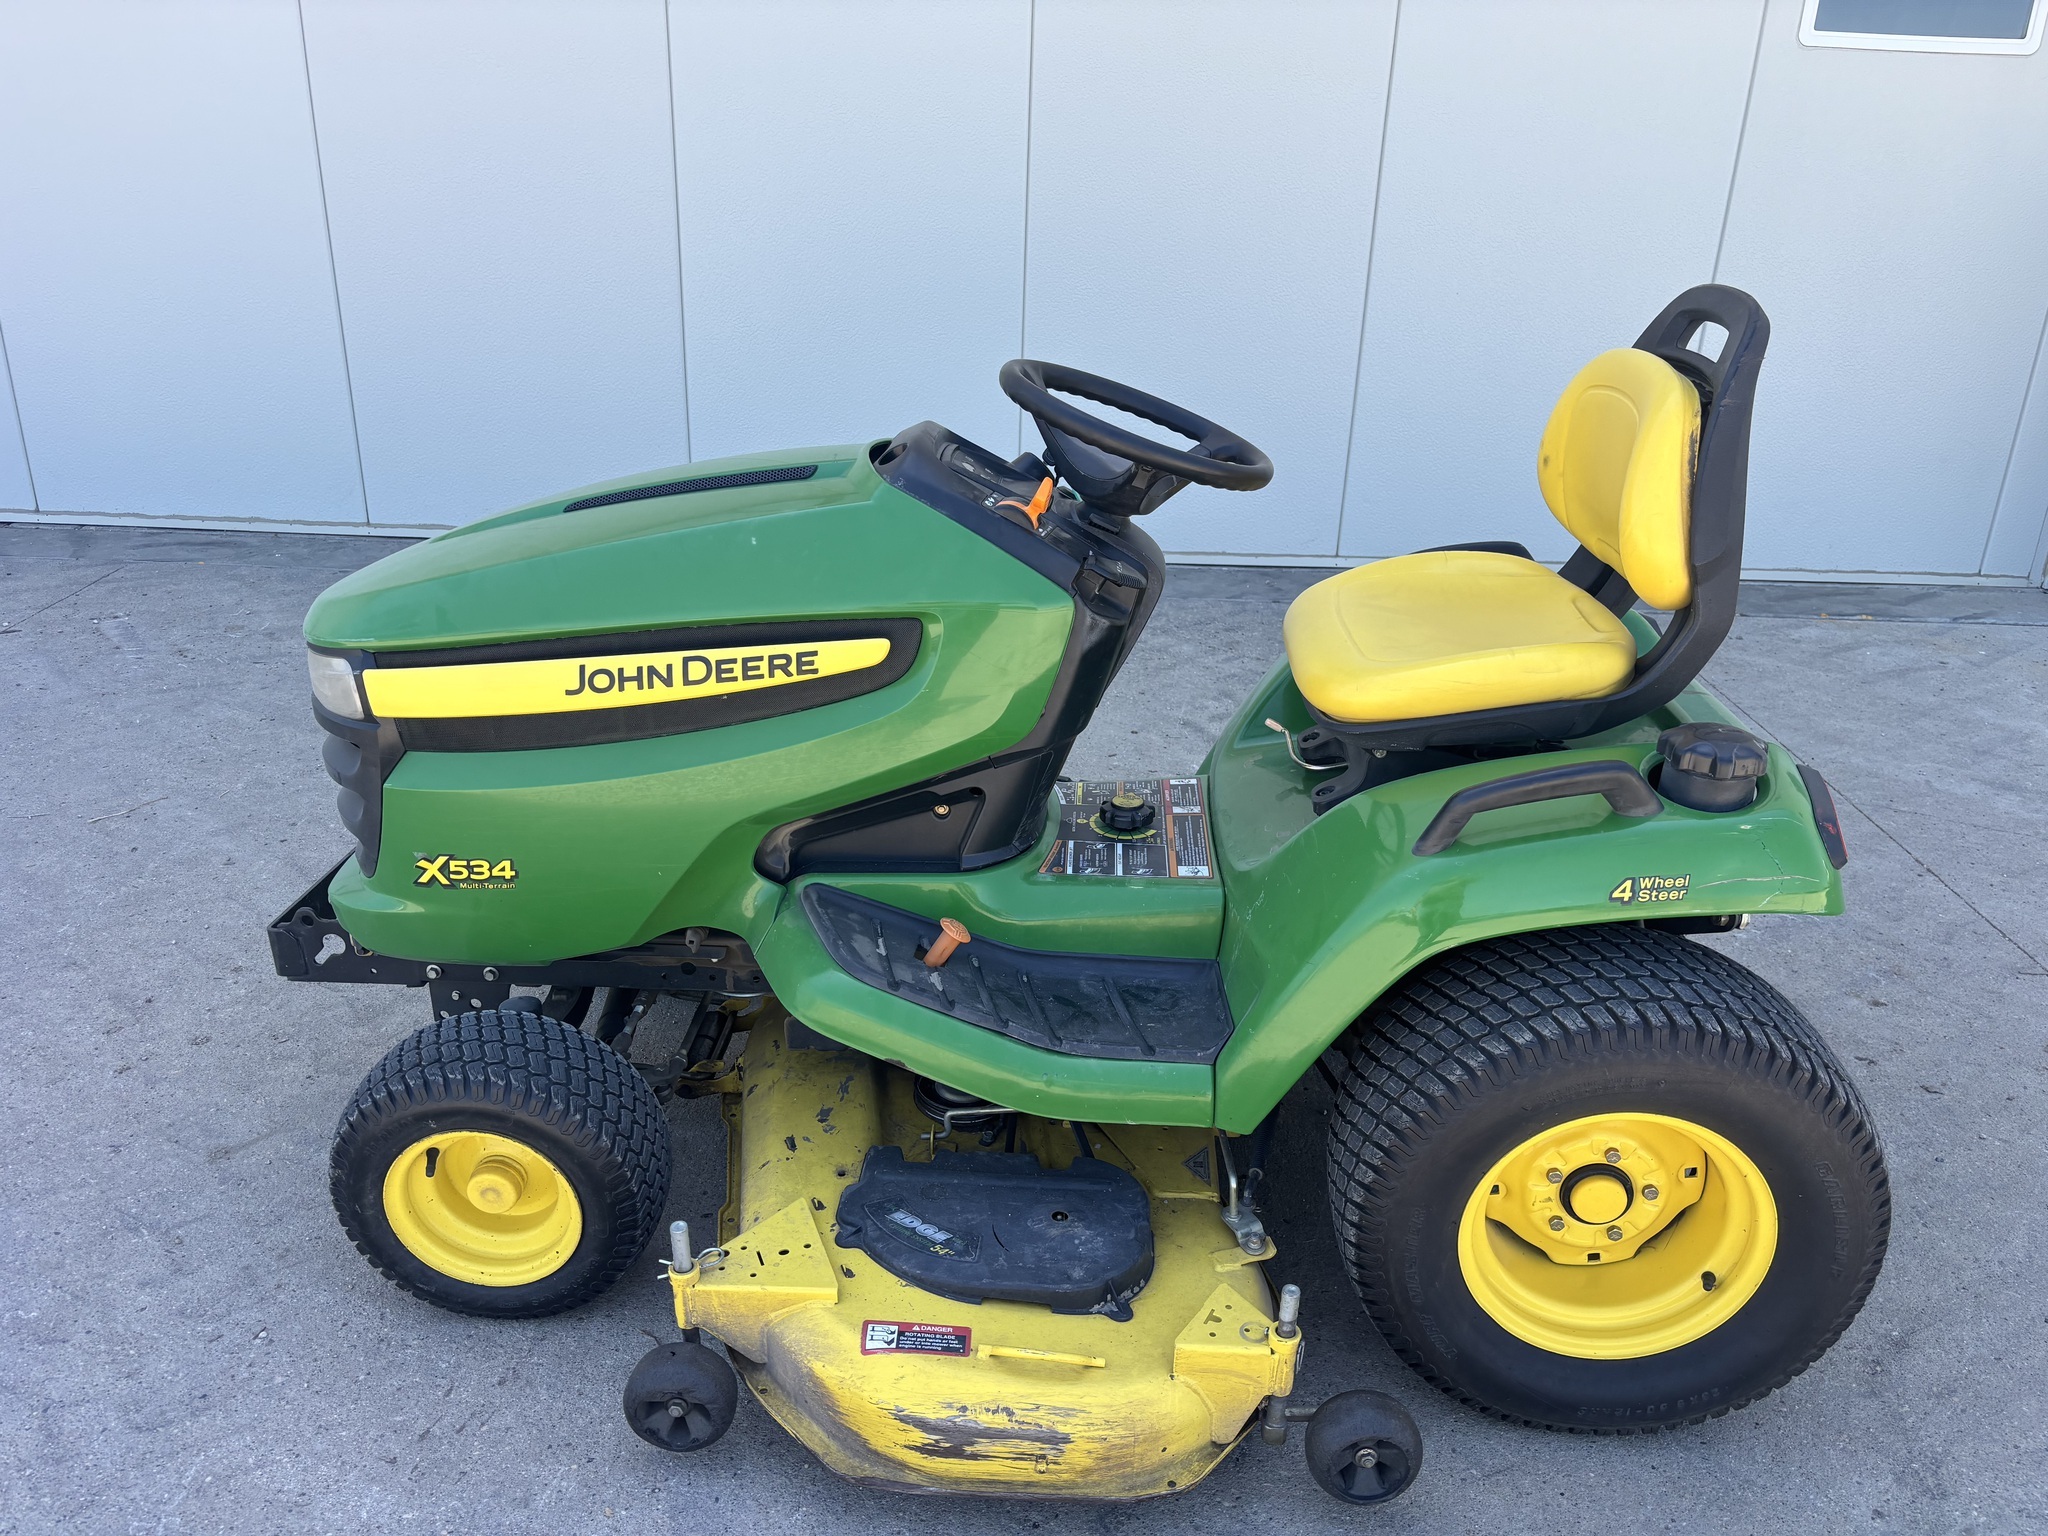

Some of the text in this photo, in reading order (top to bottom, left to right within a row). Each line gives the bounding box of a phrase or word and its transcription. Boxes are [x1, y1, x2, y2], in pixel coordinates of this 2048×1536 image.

[565, 650, 819, 695] JOHN DEERE
[413, 855, 516, 887] X534
[1639, 874, 1691, 889] Wheel
[1610, 878, 1634, 903] 4
[1637, 889, 1687, 902] Steer
[885, 1208, 953, 1243] EDGE
[921, 1325, 953, 1333] DANGER
